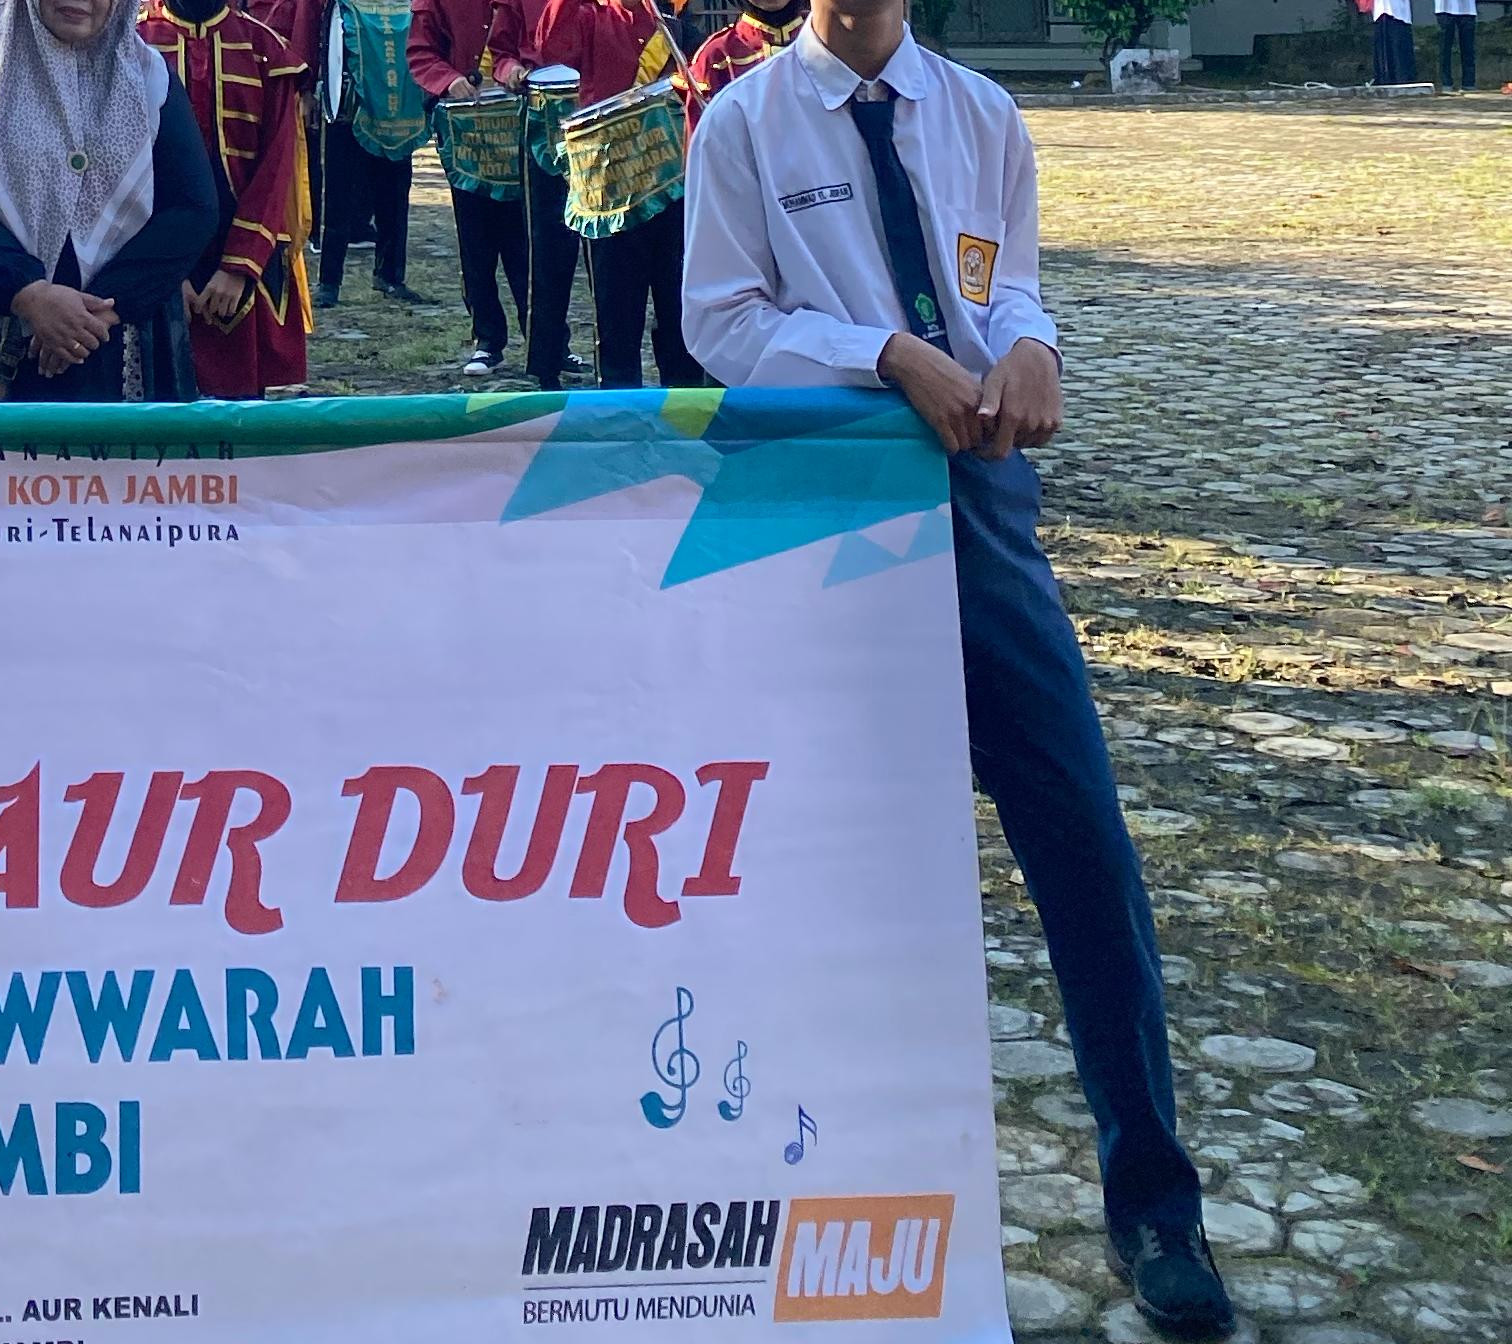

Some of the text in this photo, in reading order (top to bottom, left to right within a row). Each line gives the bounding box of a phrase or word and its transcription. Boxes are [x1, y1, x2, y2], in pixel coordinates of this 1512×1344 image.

[8, 474, 109, 505] KOTA
[122, 474, 238, 504] JAMBI
[333, 760, 771, 928] DURI
[522, 1199, 942, 1299] MADRASAH MAJU
[21, 1297, 83, 1323] AUR
[92, 1293, 199, 1321] KENALI
[522, 1293, 757, 1325] BERMUTU MENDUNIA
